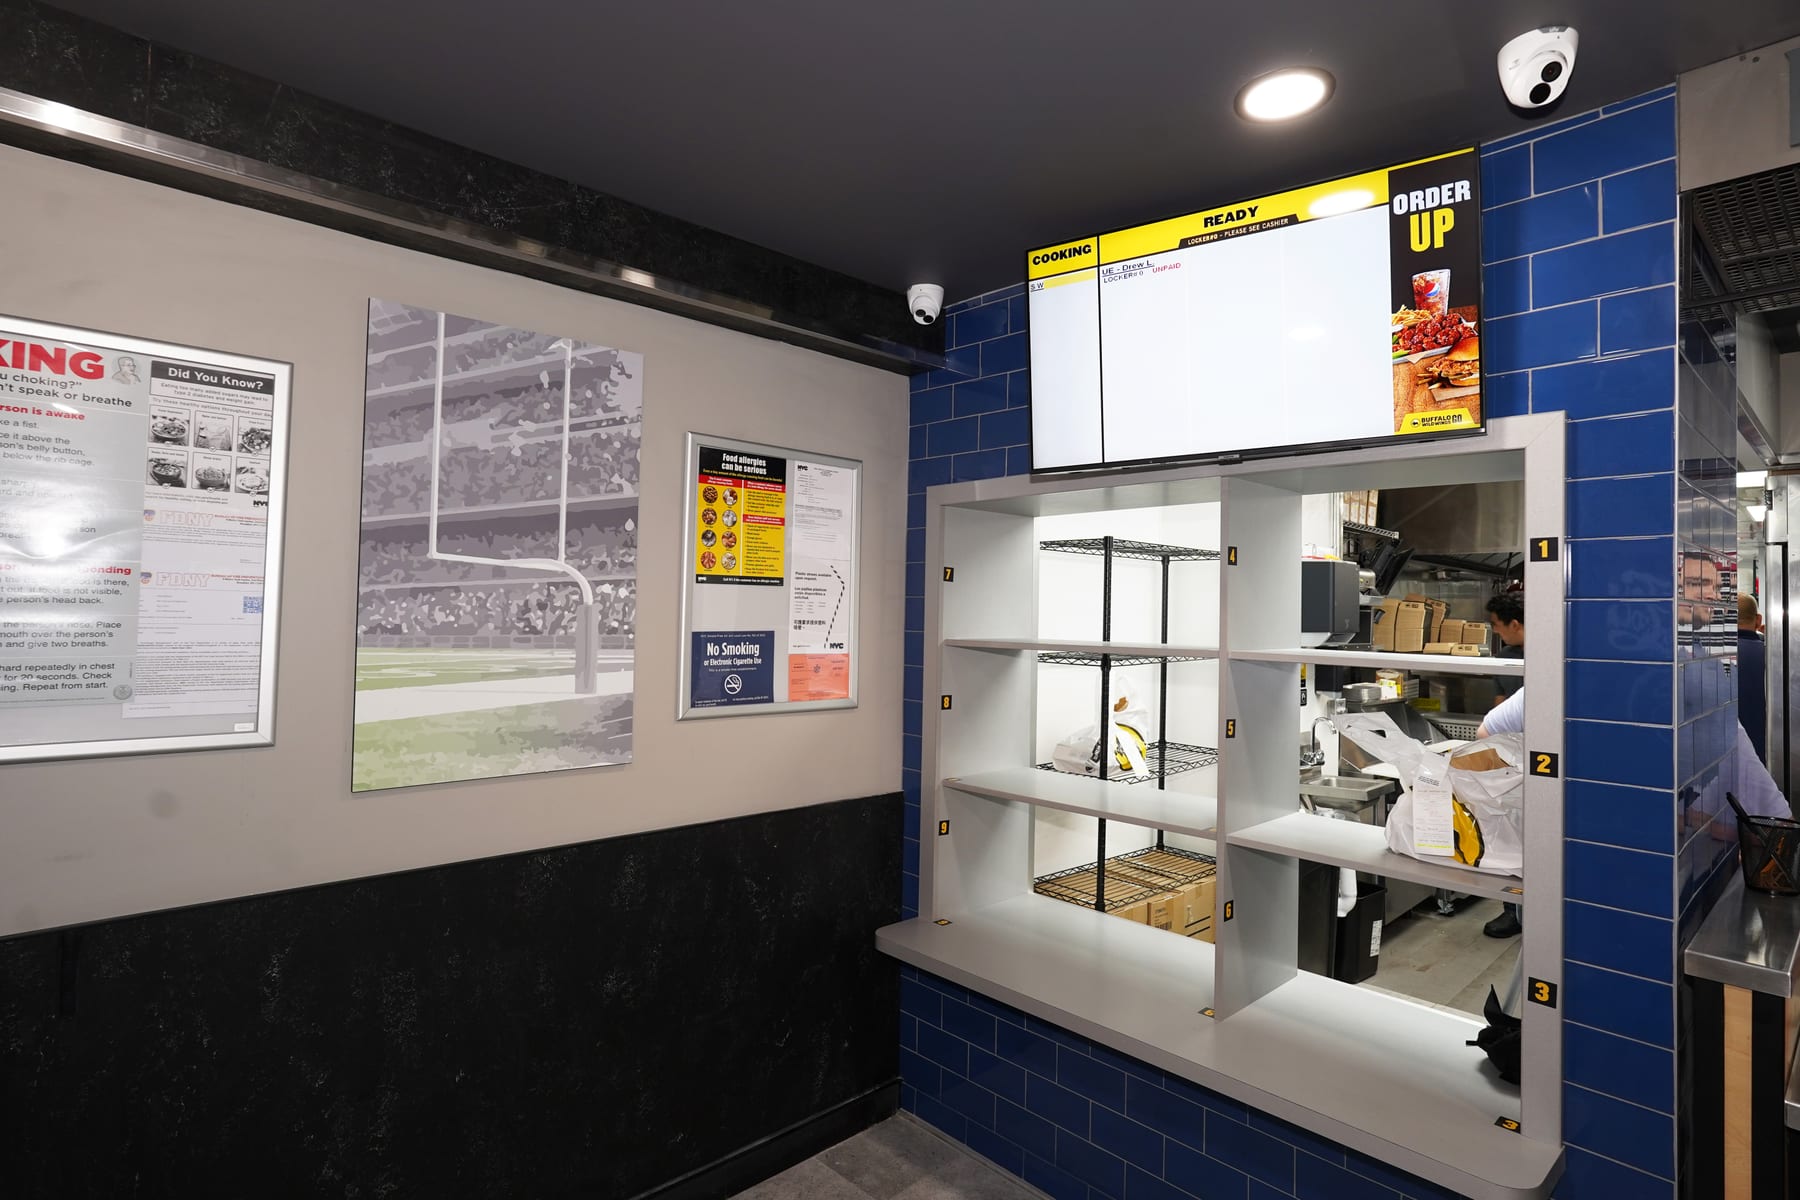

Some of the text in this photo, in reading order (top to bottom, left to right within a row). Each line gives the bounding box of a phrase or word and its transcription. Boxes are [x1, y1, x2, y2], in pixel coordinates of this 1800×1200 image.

[1393, 180, 1471, 215] ORDER
[1204, 206, 1259, 228] READY
[1224, 227, 1247, 238] PLEASE
[1249, 224, 1260, 232] SEE
[1262, 218, 1289, 229] CASHIER
[1410, 207, 1455, 252] UP
[1032, 244, 1092, 265] COOKING
[1102, 267, 1114, 276] UE
[1122, 261, 1145, 271] Drew
[1152, 262, 1181, 273] UNPAID
[168, 367, 263, 390] Did You Know?
[19, 386, 59, 398] speak
[64, 392, 78, 400] or
[83, 392, 132, 407] breathe
[32, 406, 42, 415] is
[46, 409, 85, 420] awake
[1421, 415, 1451, 423] BUFFALO
[22, 434, 52, 443] above
[55, 437, 70, 445] the
[27, 444, 50, 453] belly
[3, 452, 32, 460] below
[723, 453, 766, 466] Food allergies
[734, 464, 742, 472] be
[743, 466, 767, 475] serious
[159, 509, 214, 527] FDNY
[1230, 548, 1235, 563] 4
[1538, 539, 1549, 559] 1
[156, 572, 211, 587] FDNY
[945, 568, 951, 580] 7
[103, 578, 129, 587] there,
[91, 587, 122, 596] visible,
[6, 596, 49, 604] person's
[56, 630, 71, 638] the
[74, 630, 114, 639] person's
[27, 641, 48, 650] give
[707, 641, 760, 656] No Smoking
[25, 663, 76, 672] repeatedly
[710, 658, 732, 666] Electronic
[733, 657, 753, 666] Cigarette
[22, 683, 58, 691] Repeat
[85, 681, 108, 689] start.
[943, 696, 949, 708] 8
[1228, 720, 1234, 736] 5
[1536, 754, 1551, 773] 2
[941, 822, 947, 833] 9
[1226, 902, 1232, 918] 6
[1534, 982, 1550, 1002] 3
[1503, 1120, 1518, 1130] 3
